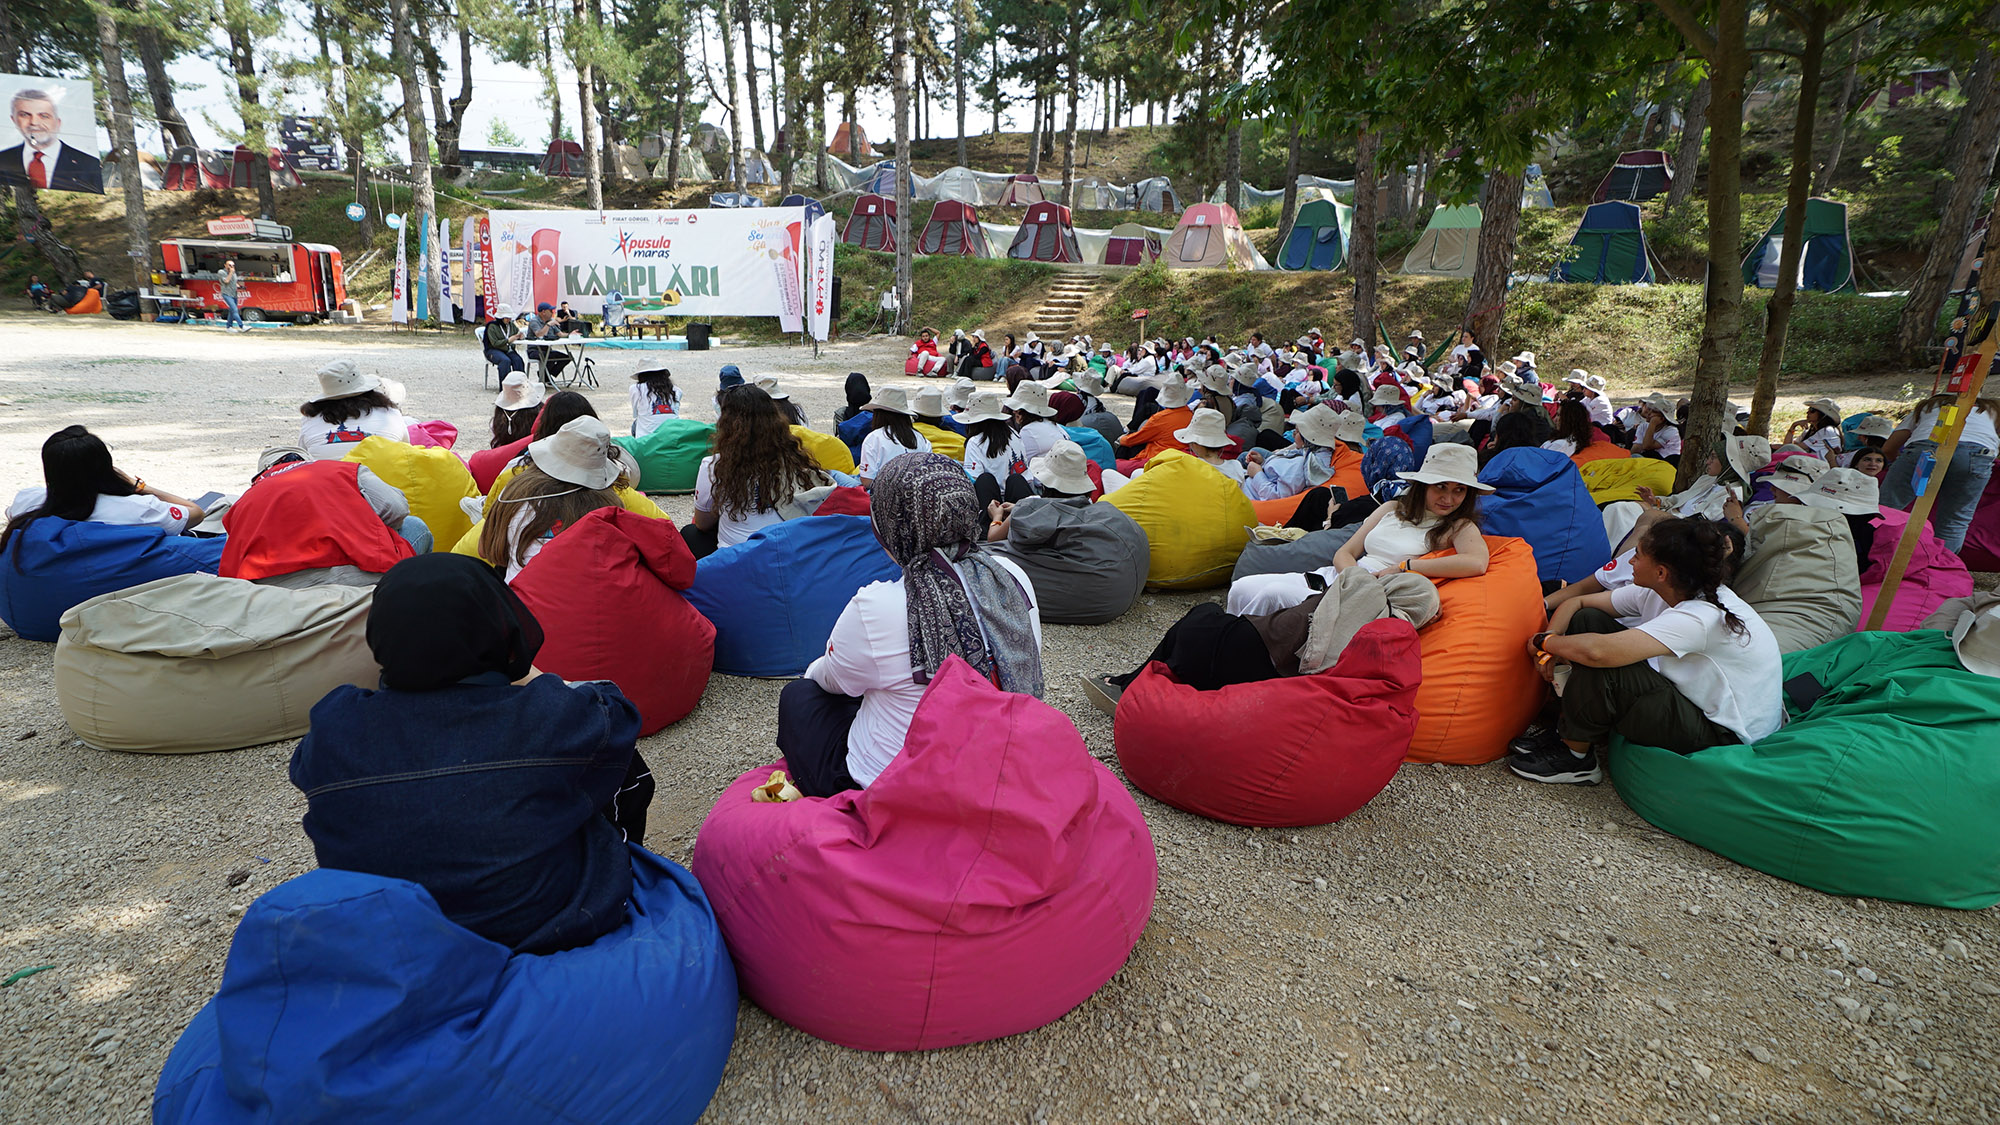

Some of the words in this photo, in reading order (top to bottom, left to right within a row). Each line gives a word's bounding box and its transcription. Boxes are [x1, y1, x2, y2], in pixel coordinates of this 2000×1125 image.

[628, 235, 672, 253] pusula
[633, 249, 671, 259] maraş
[441, 250, 451, 299] AFAD
[482, 251, 496, 319] ANDIRIN
[564, 263, 720, 297] KAMPLARI
